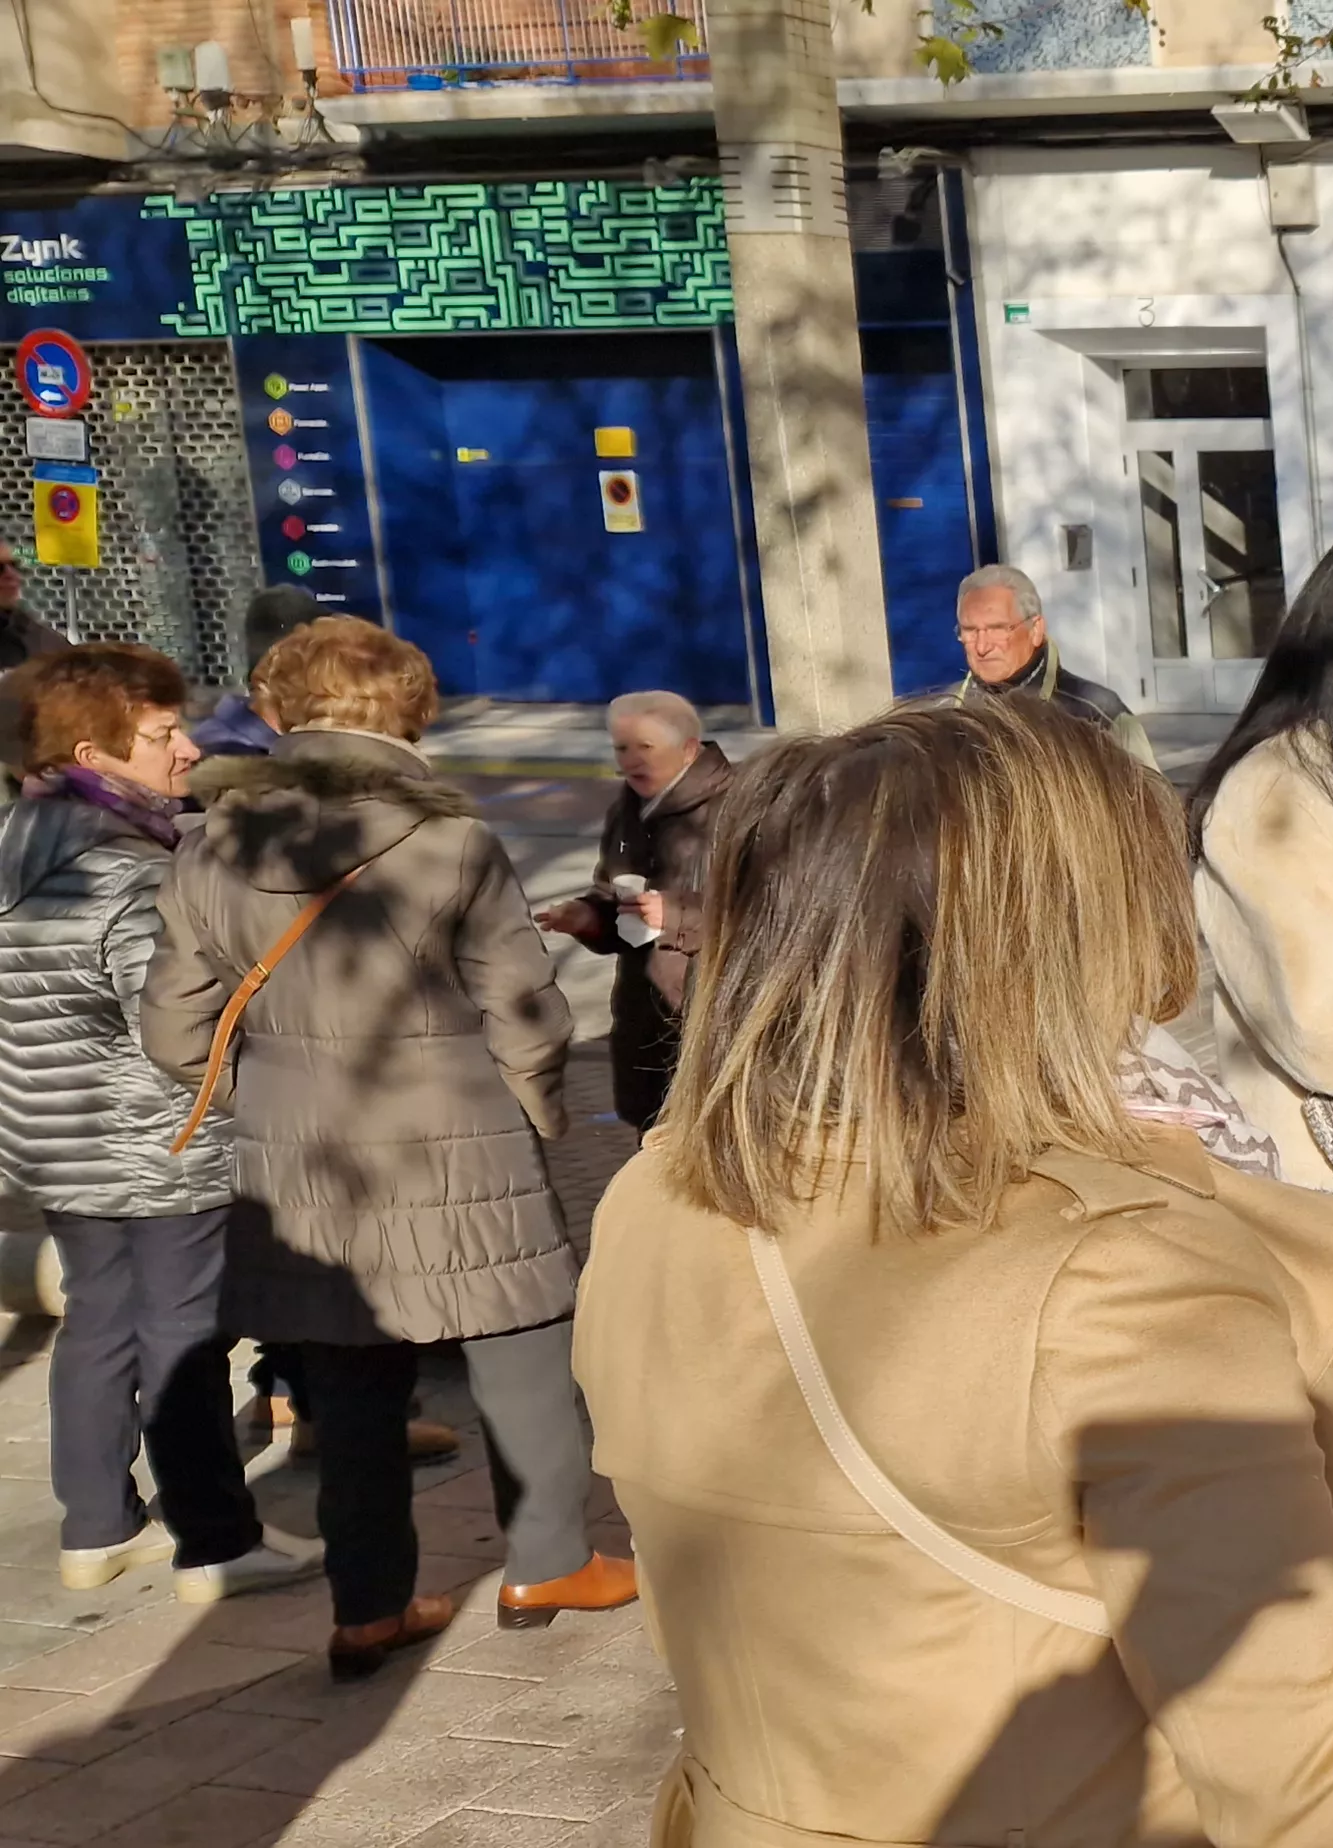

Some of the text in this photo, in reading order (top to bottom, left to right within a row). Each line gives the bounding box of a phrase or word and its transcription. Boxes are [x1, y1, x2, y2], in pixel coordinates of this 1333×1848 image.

[0, 233, 84, 267] Zynk
[3, 265, 109, 284] soluciones
[6, 286, 90, 306] digitales
[1137, 297, 1156, 328] 3
